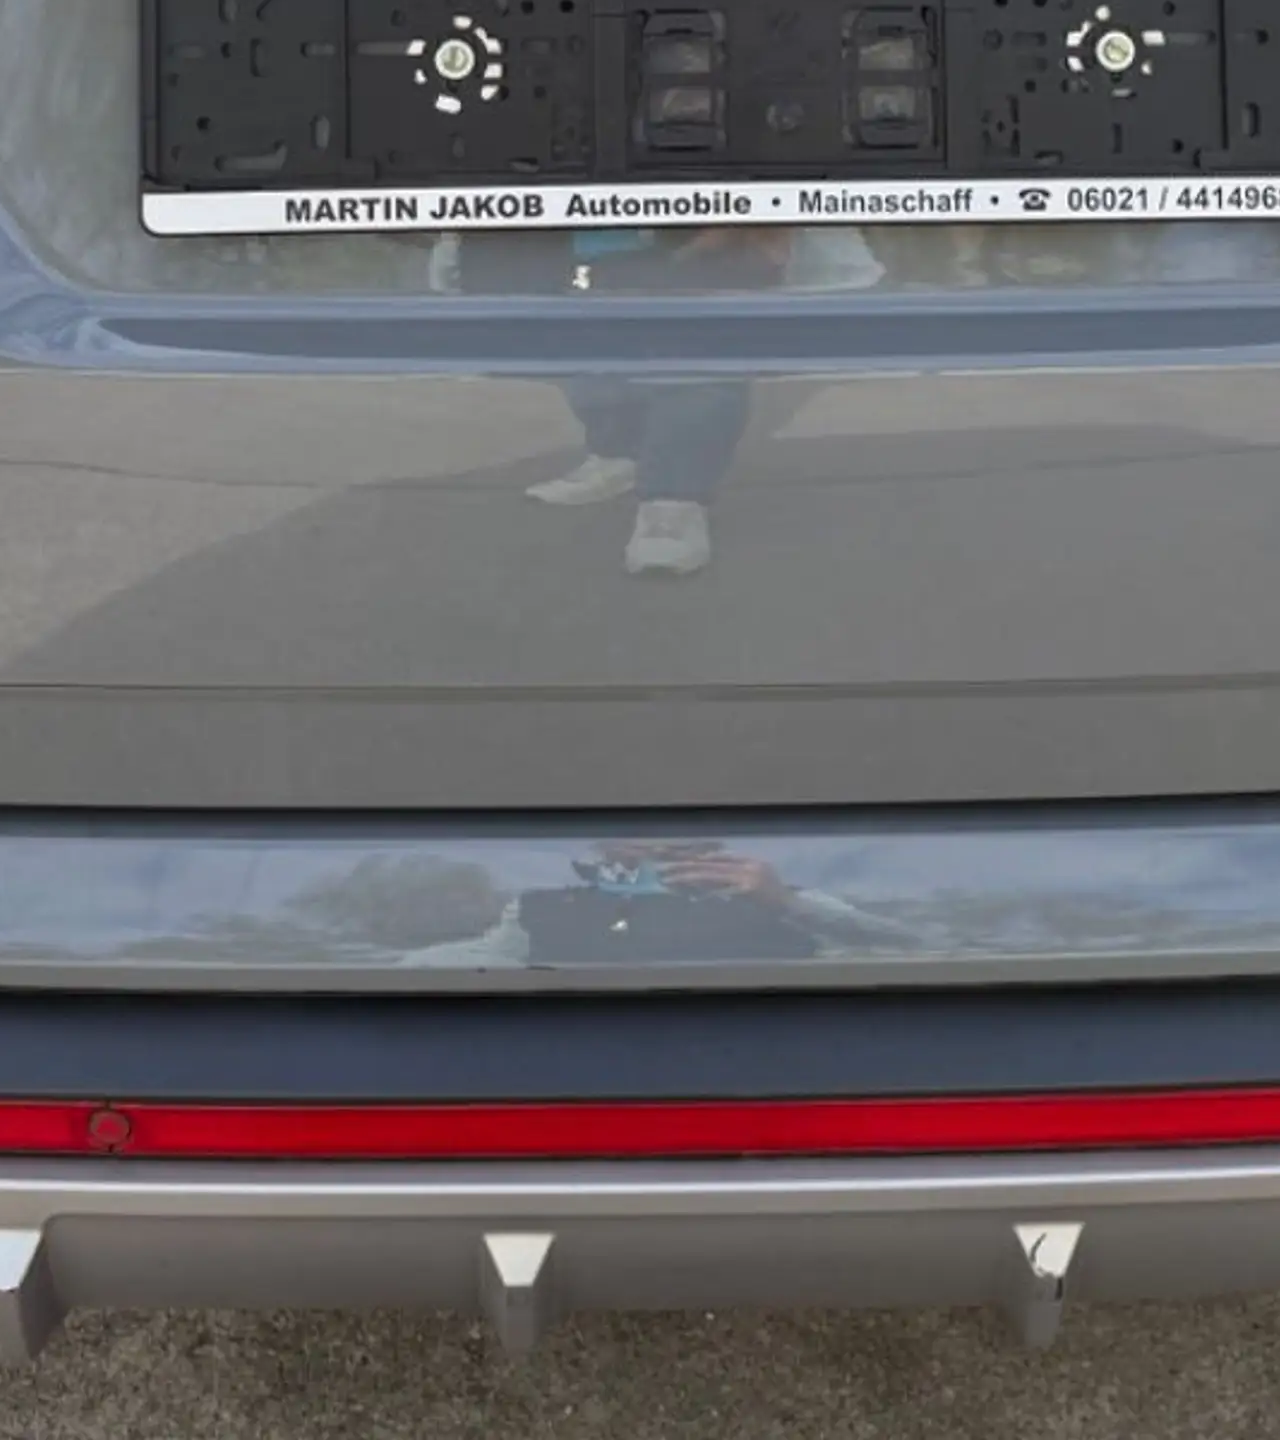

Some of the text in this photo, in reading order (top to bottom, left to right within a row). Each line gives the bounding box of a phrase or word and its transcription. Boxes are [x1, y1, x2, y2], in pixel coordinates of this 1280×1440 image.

[285, 195, 420, 224] MARTIN
[428, 193, 544, 221] JAKOB
[564, 189, 753, 218] Automobile
[798, 188, 973, 216] Mainaschaff
[1066, 187, 1150, 213] 06021
